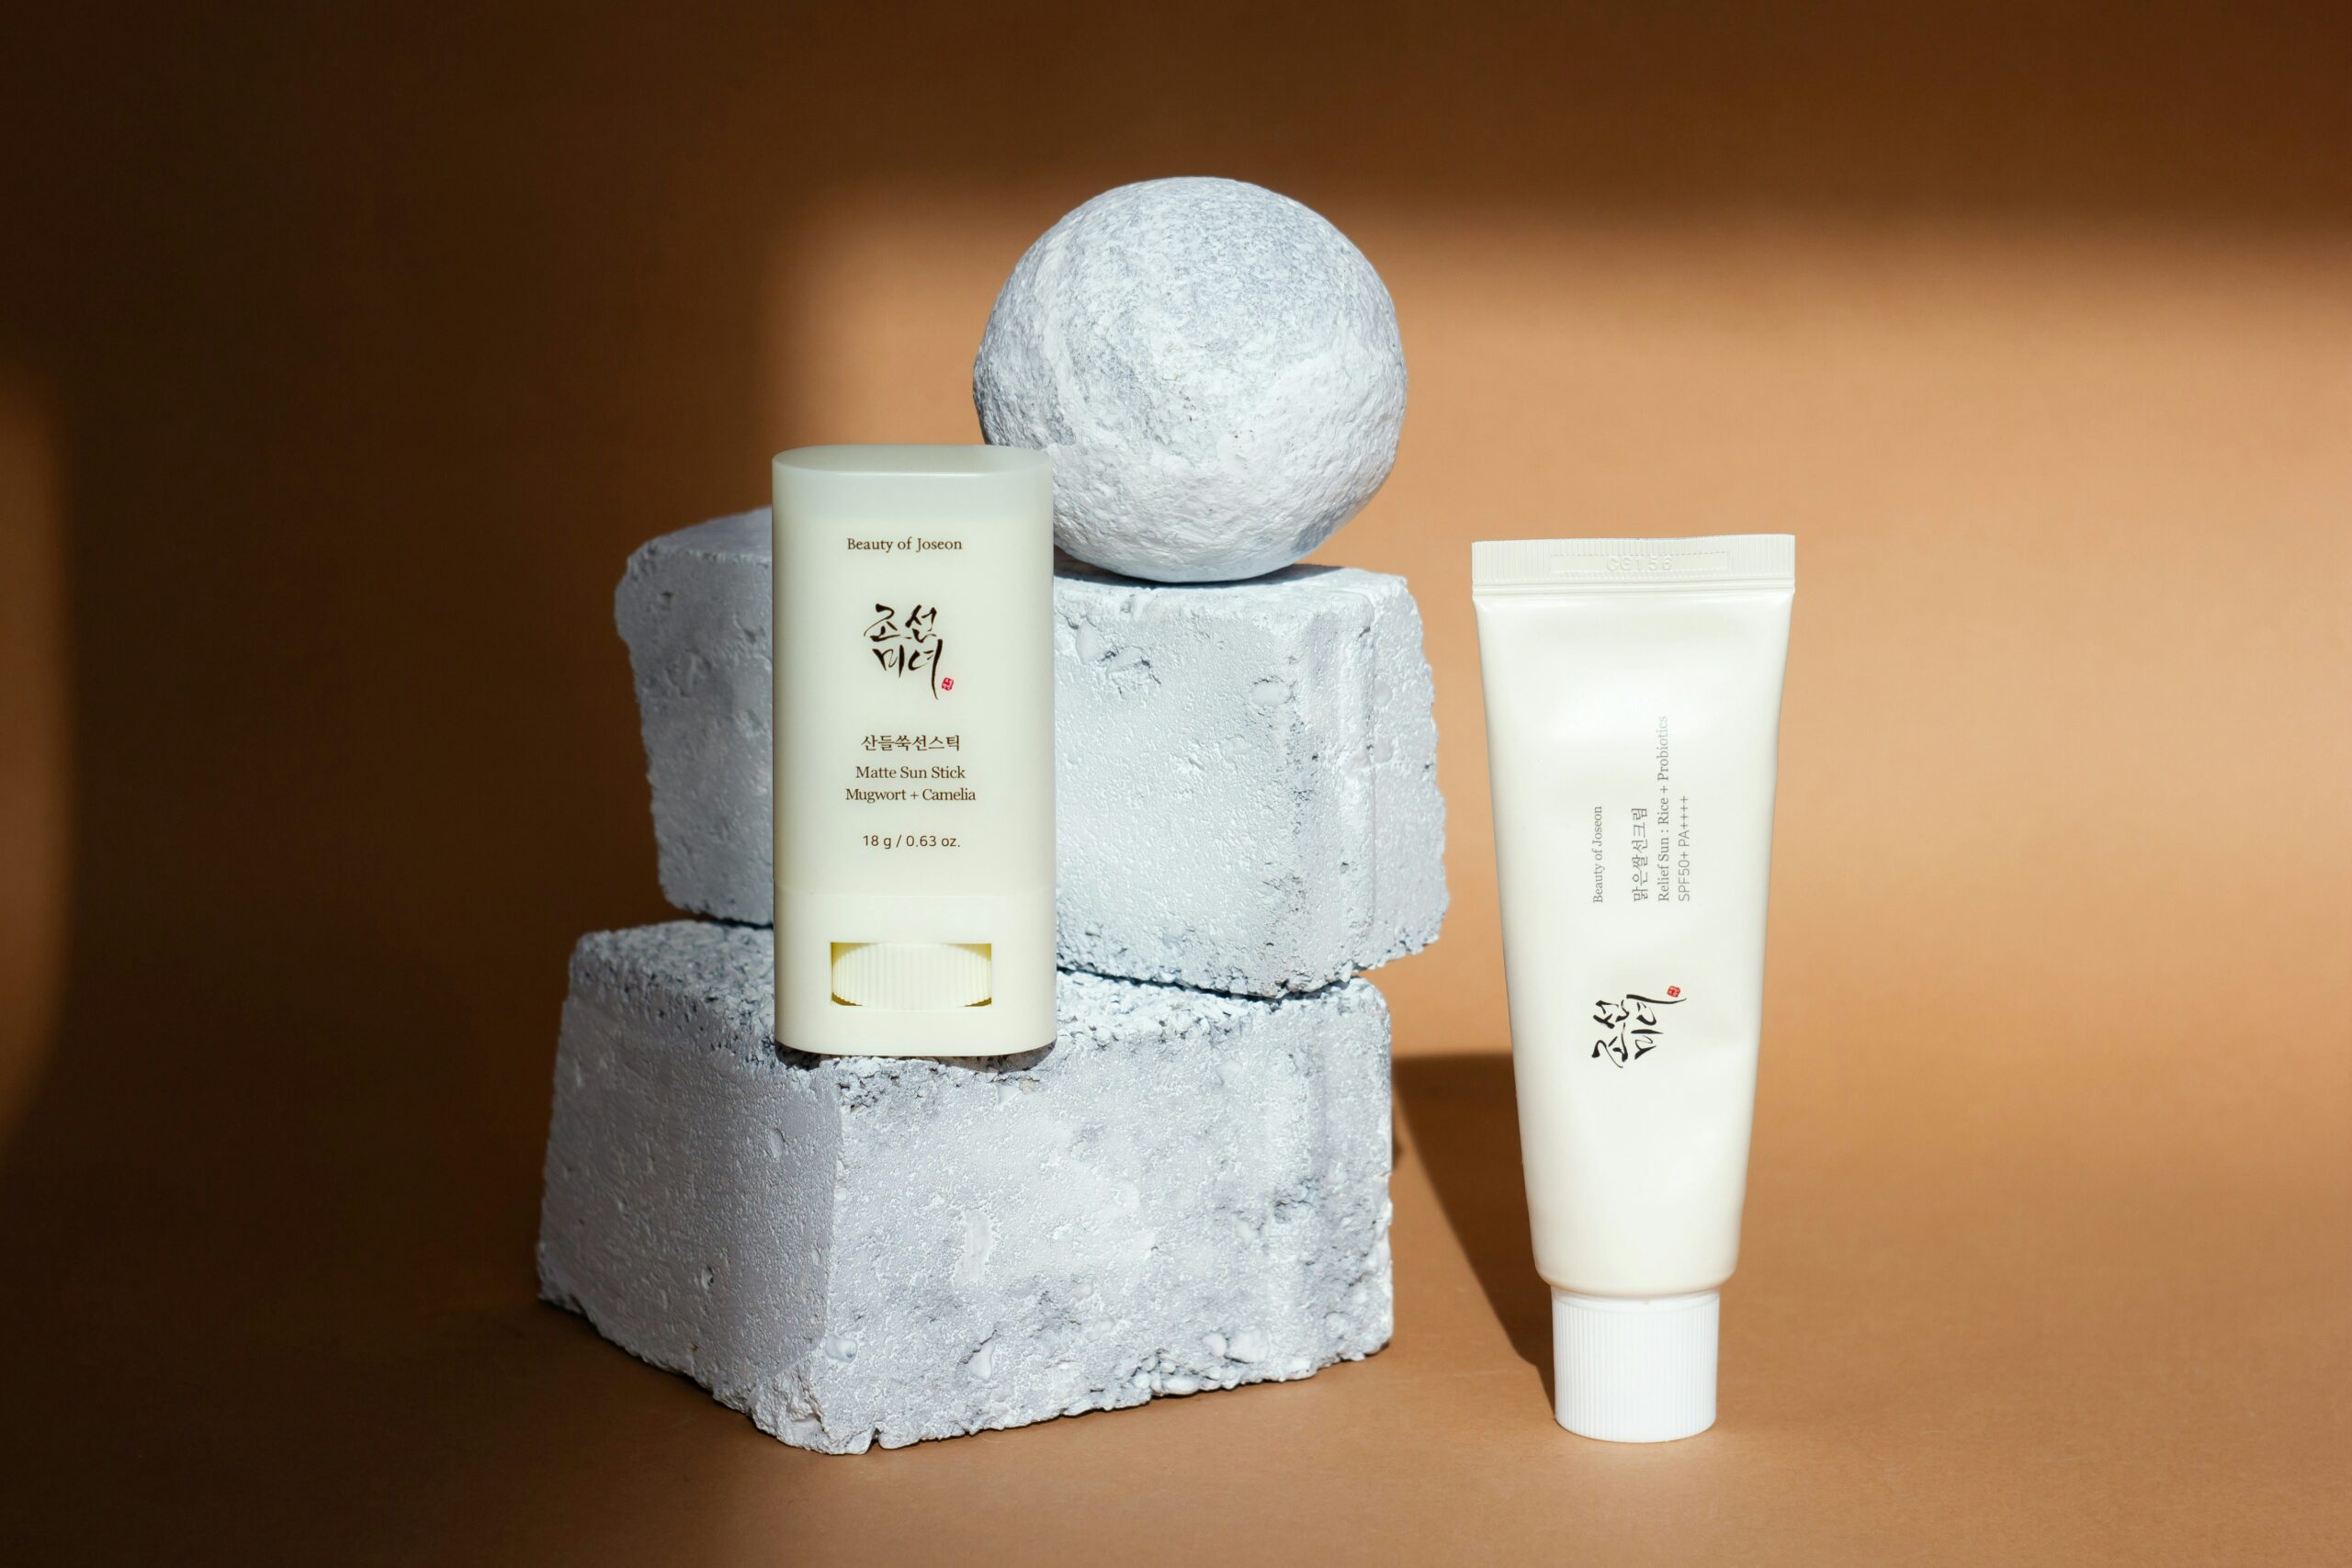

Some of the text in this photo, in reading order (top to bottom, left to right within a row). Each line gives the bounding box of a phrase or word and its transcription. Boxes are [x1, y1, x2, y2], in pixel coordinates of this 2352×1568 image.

[847, 536, 963, 553] Beauty of Joseon
[864, 603, 938, 643] 조선
[872, 639, 944, 700] 미녀
[861, 734, 960, 751] 산들쑥선스틱
[1656, 715, 1669, 782] Probiotics
[855, 765, 966, 779] Matte Sun Stick
[845, 787, 977, 804] Mugwort + Camelia
[1657, 797, 1669, 826] Rice
[863, 834, 961, 850] 18 g / 0.63 oz.
[1591, 806, 1605, 904] Beauty of Joseon
[1631, 807, 1648, 902] 맑은쌀선크림
[1657, 837, 1669, 862] Sun
[1677, 795, 1690, 902] SPF50+ PA++++
[1657, 863, 1669, 902] Relief
